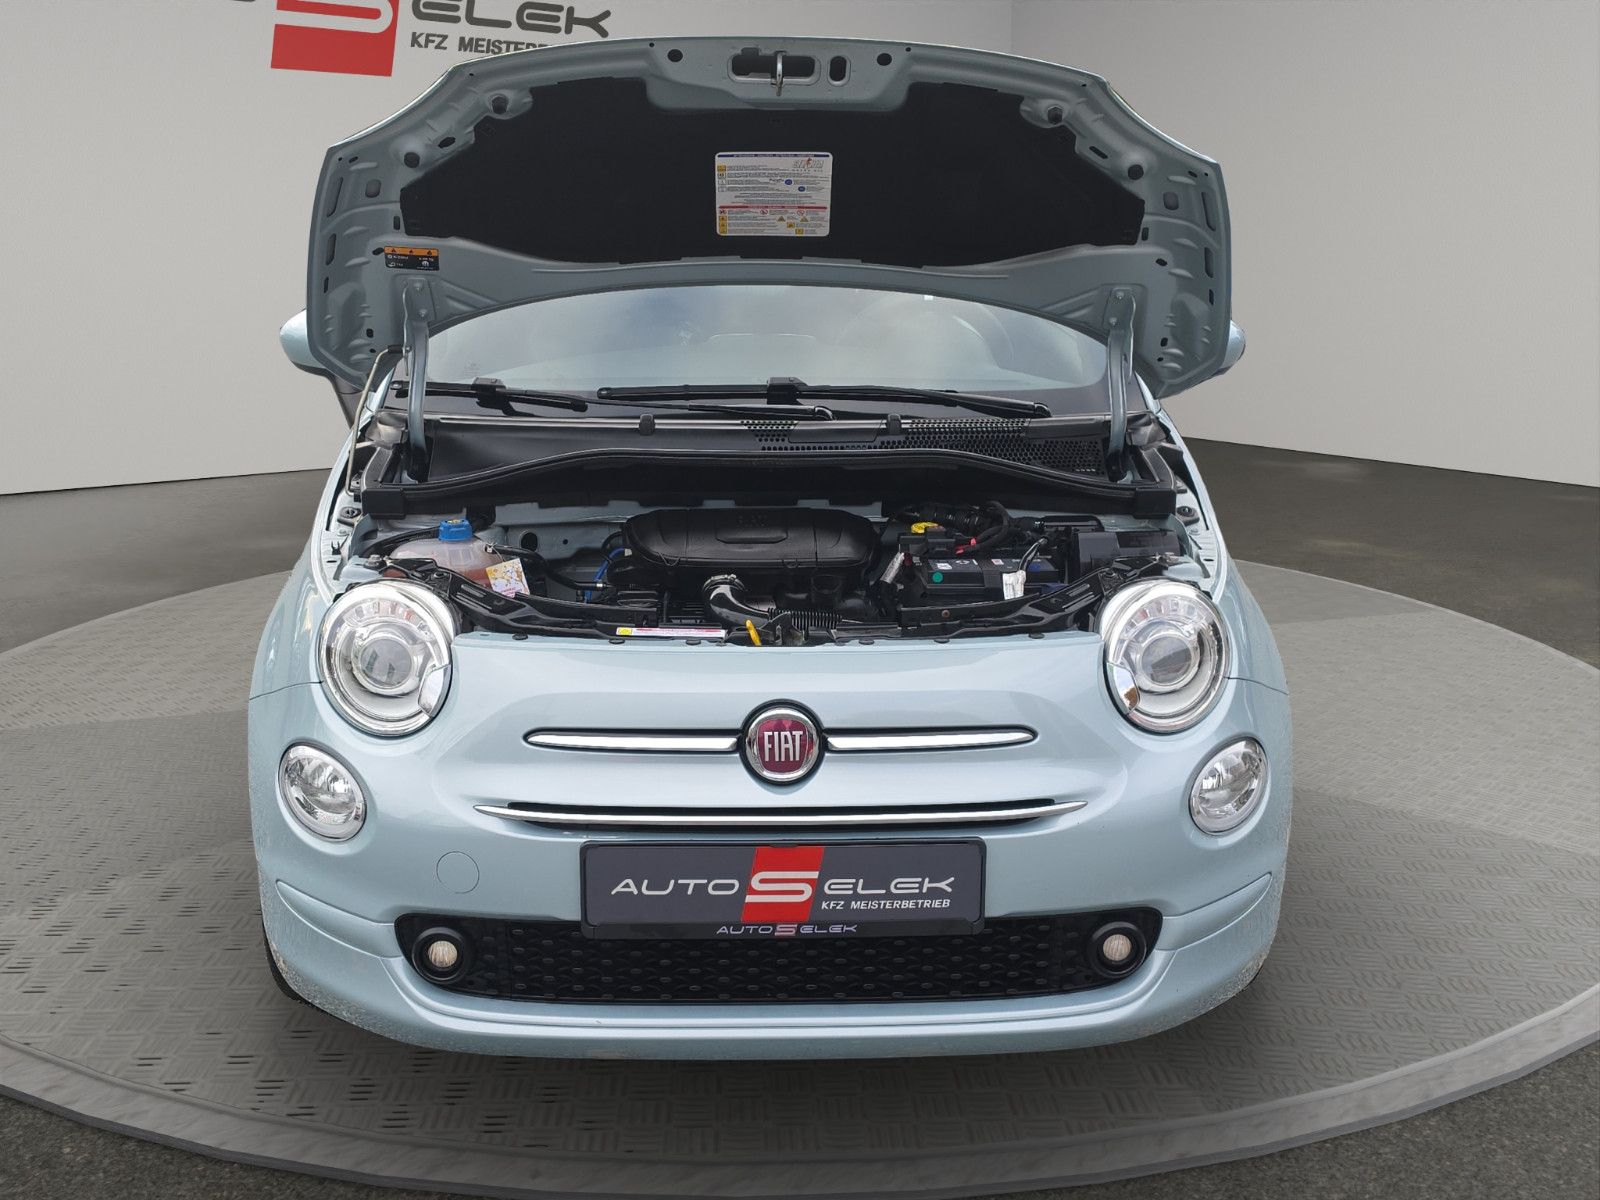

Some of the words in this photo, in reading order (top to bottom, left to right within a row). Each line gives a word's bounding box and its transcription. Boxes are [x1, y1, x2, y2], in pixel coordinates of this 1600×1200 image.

[410, 31, 449, 51] KFZ
[763, 730, 804, 762] FIAT
[821, 900, 845, 911] KFZ
[850, 898, 951, 910] MEISTERBETRIEB
